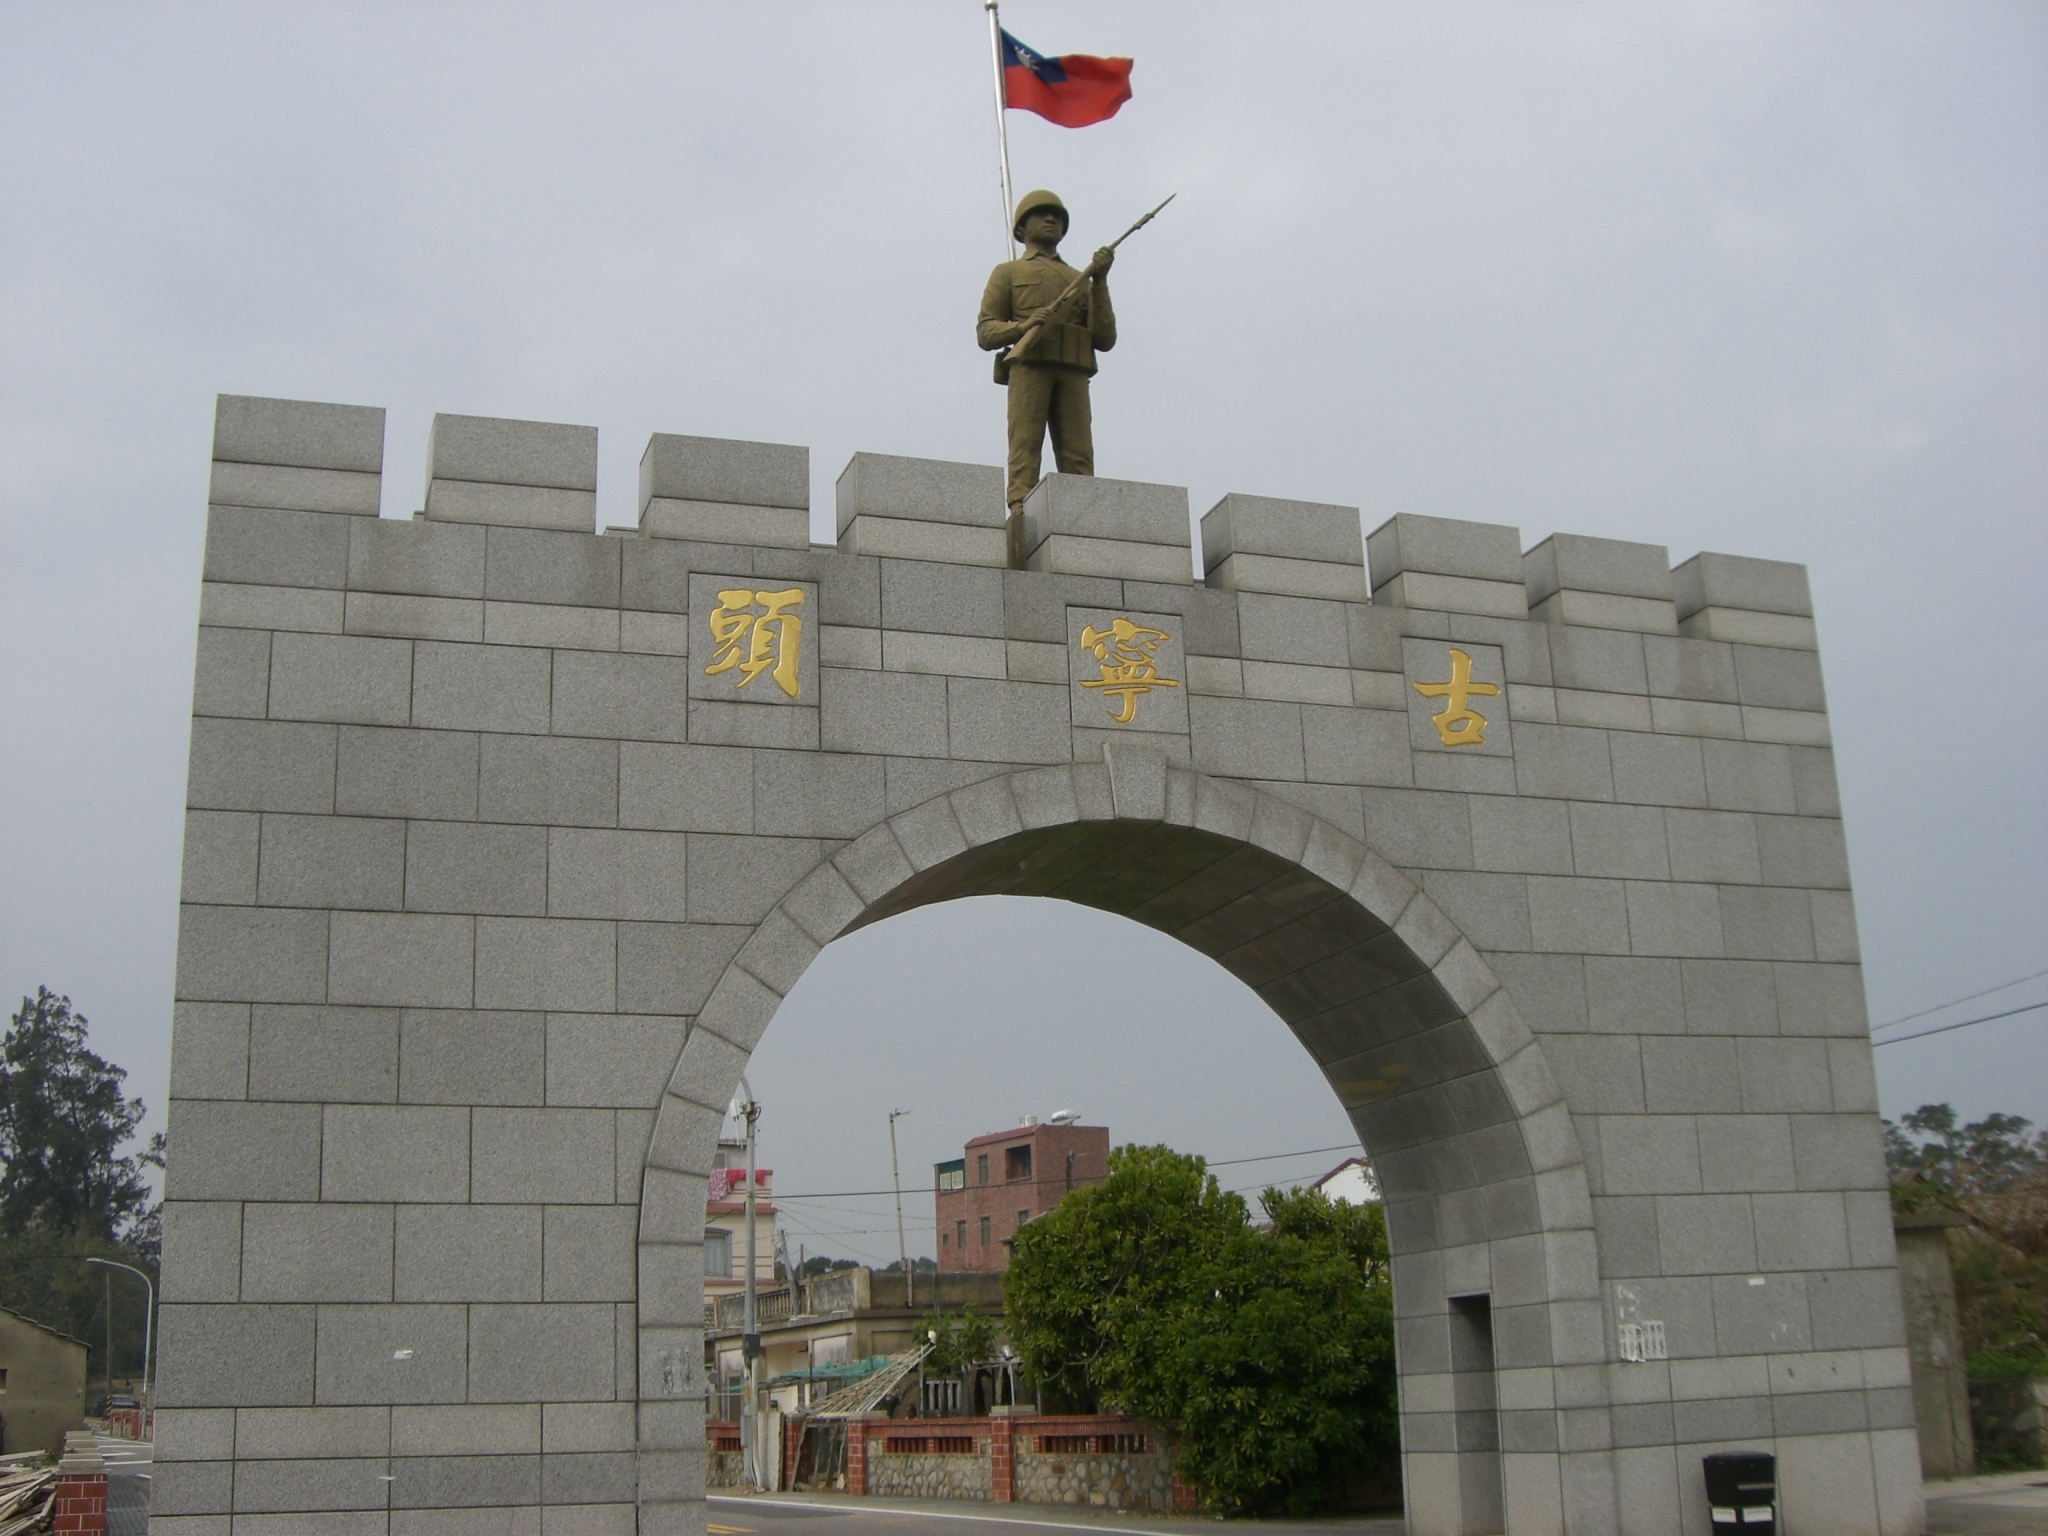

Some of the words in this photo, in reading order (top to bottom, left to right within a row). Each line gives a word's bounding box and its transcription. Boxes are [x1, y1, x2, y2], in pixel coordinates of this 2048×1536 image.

[705, 588, 804, 698] 頭
[1080, 618, 1180, 724] 寧
[1413, 649, 1501, 748] 古
